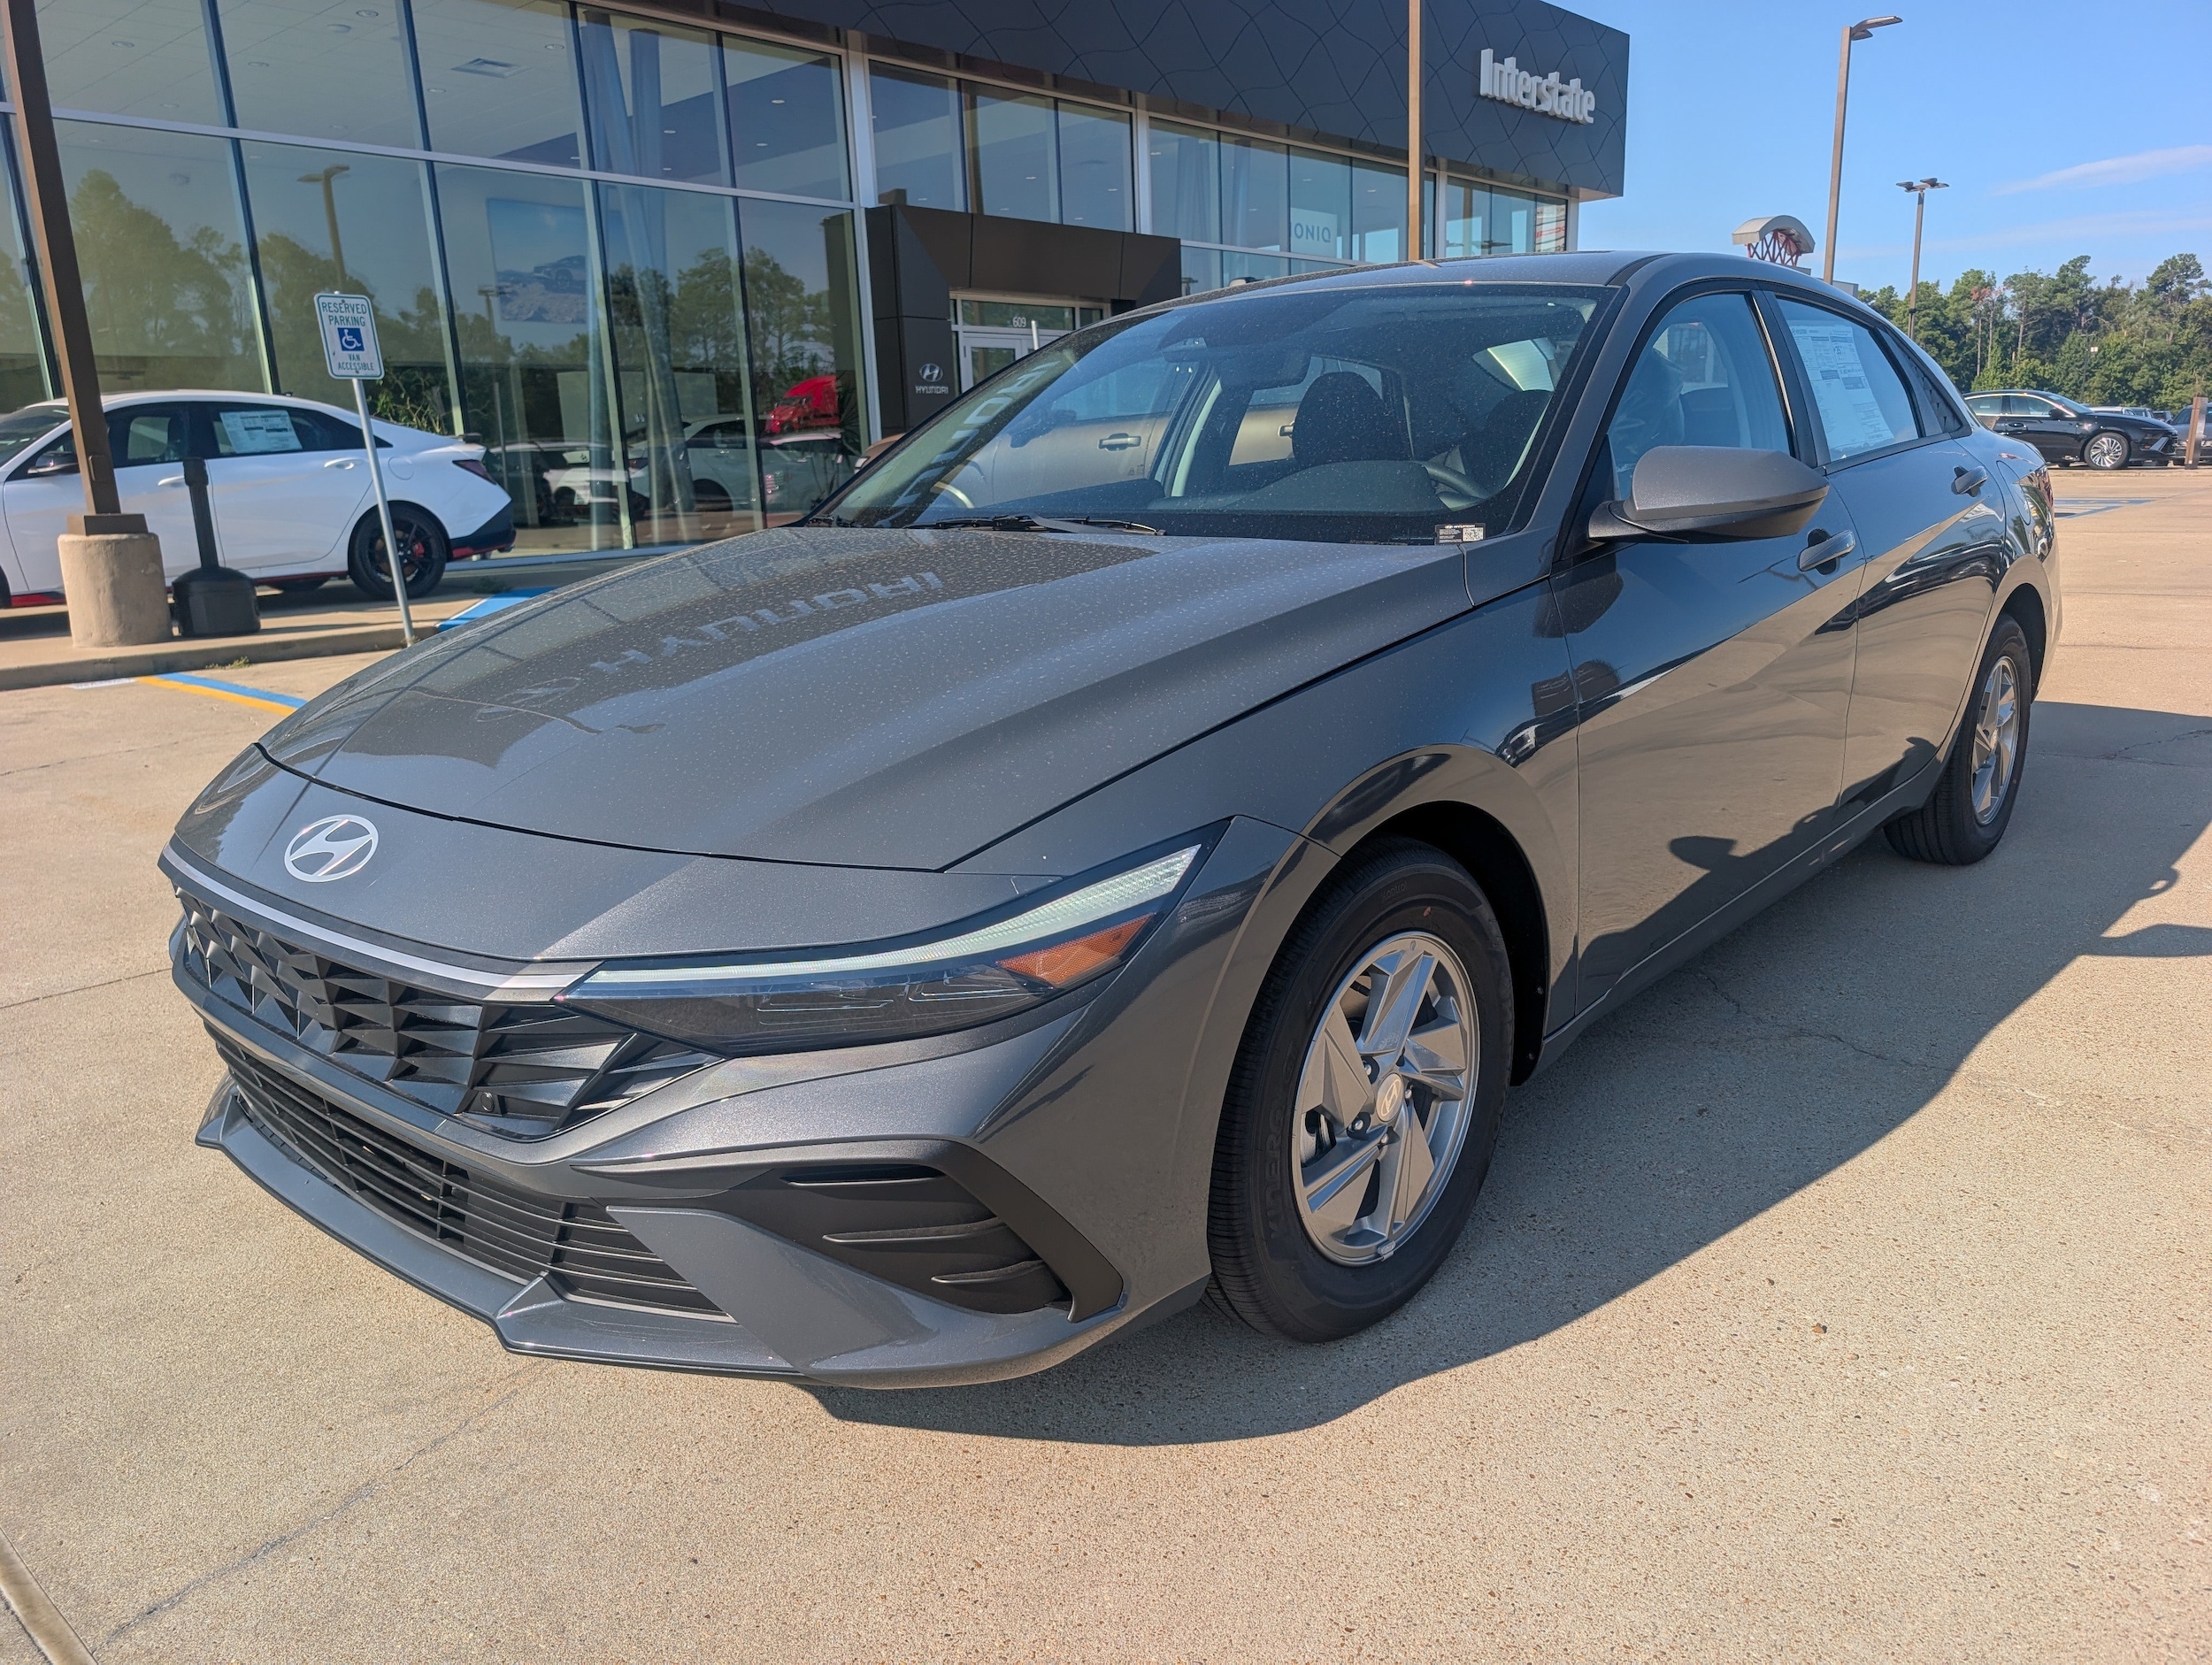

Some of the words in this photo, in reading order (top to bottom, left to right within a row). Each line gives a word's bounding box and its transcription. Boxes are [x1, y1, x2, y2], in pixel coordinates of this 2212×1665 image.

[1479, 48, 1595, 125] Interstate
[1294, 222, 1331, 243] ONIQ
[321, 302, 367, 315] RESERVED
[328, 315, 365, 326] PARKING
[1012, 317, 1027, 328] 609
[337, 362, 374, 371] ACCESSIBLE
[915, 386, 949, 395] HYUNDAI
